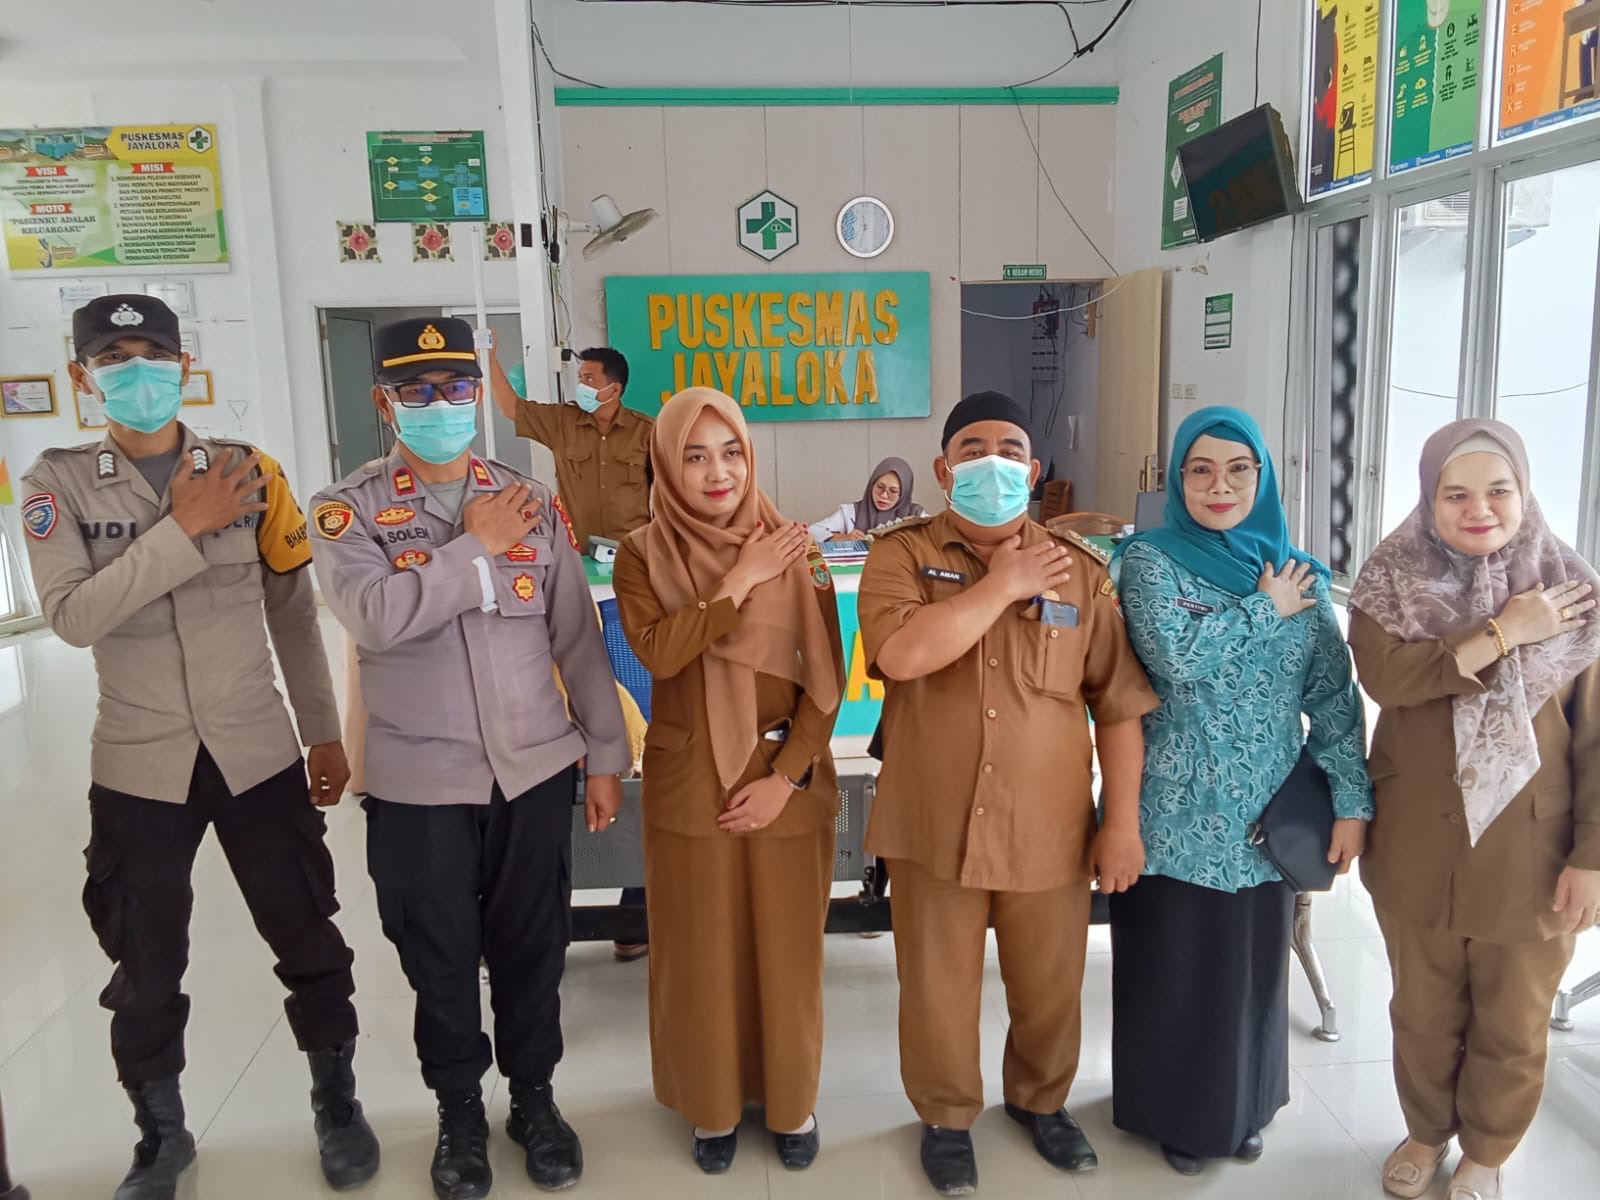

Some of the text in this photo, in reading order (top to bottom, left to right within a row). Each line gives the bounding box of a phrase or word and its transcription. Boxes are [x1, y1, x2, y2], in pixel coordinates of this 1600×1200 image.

[120, 131, 185, 142] PUSKESMAS
[127, 141, 180, 151] JAYALOKA
[35, 166, 58, 176] VISI
[140, 163, 165, 173] MISI
[35, 204, 66, 213] MOTO
[648, 288, 899, 350] PUSKESMAS
[659, 349, 880, 406] JAYALOKA
[927, 568, 961, 581] AL AMAN
